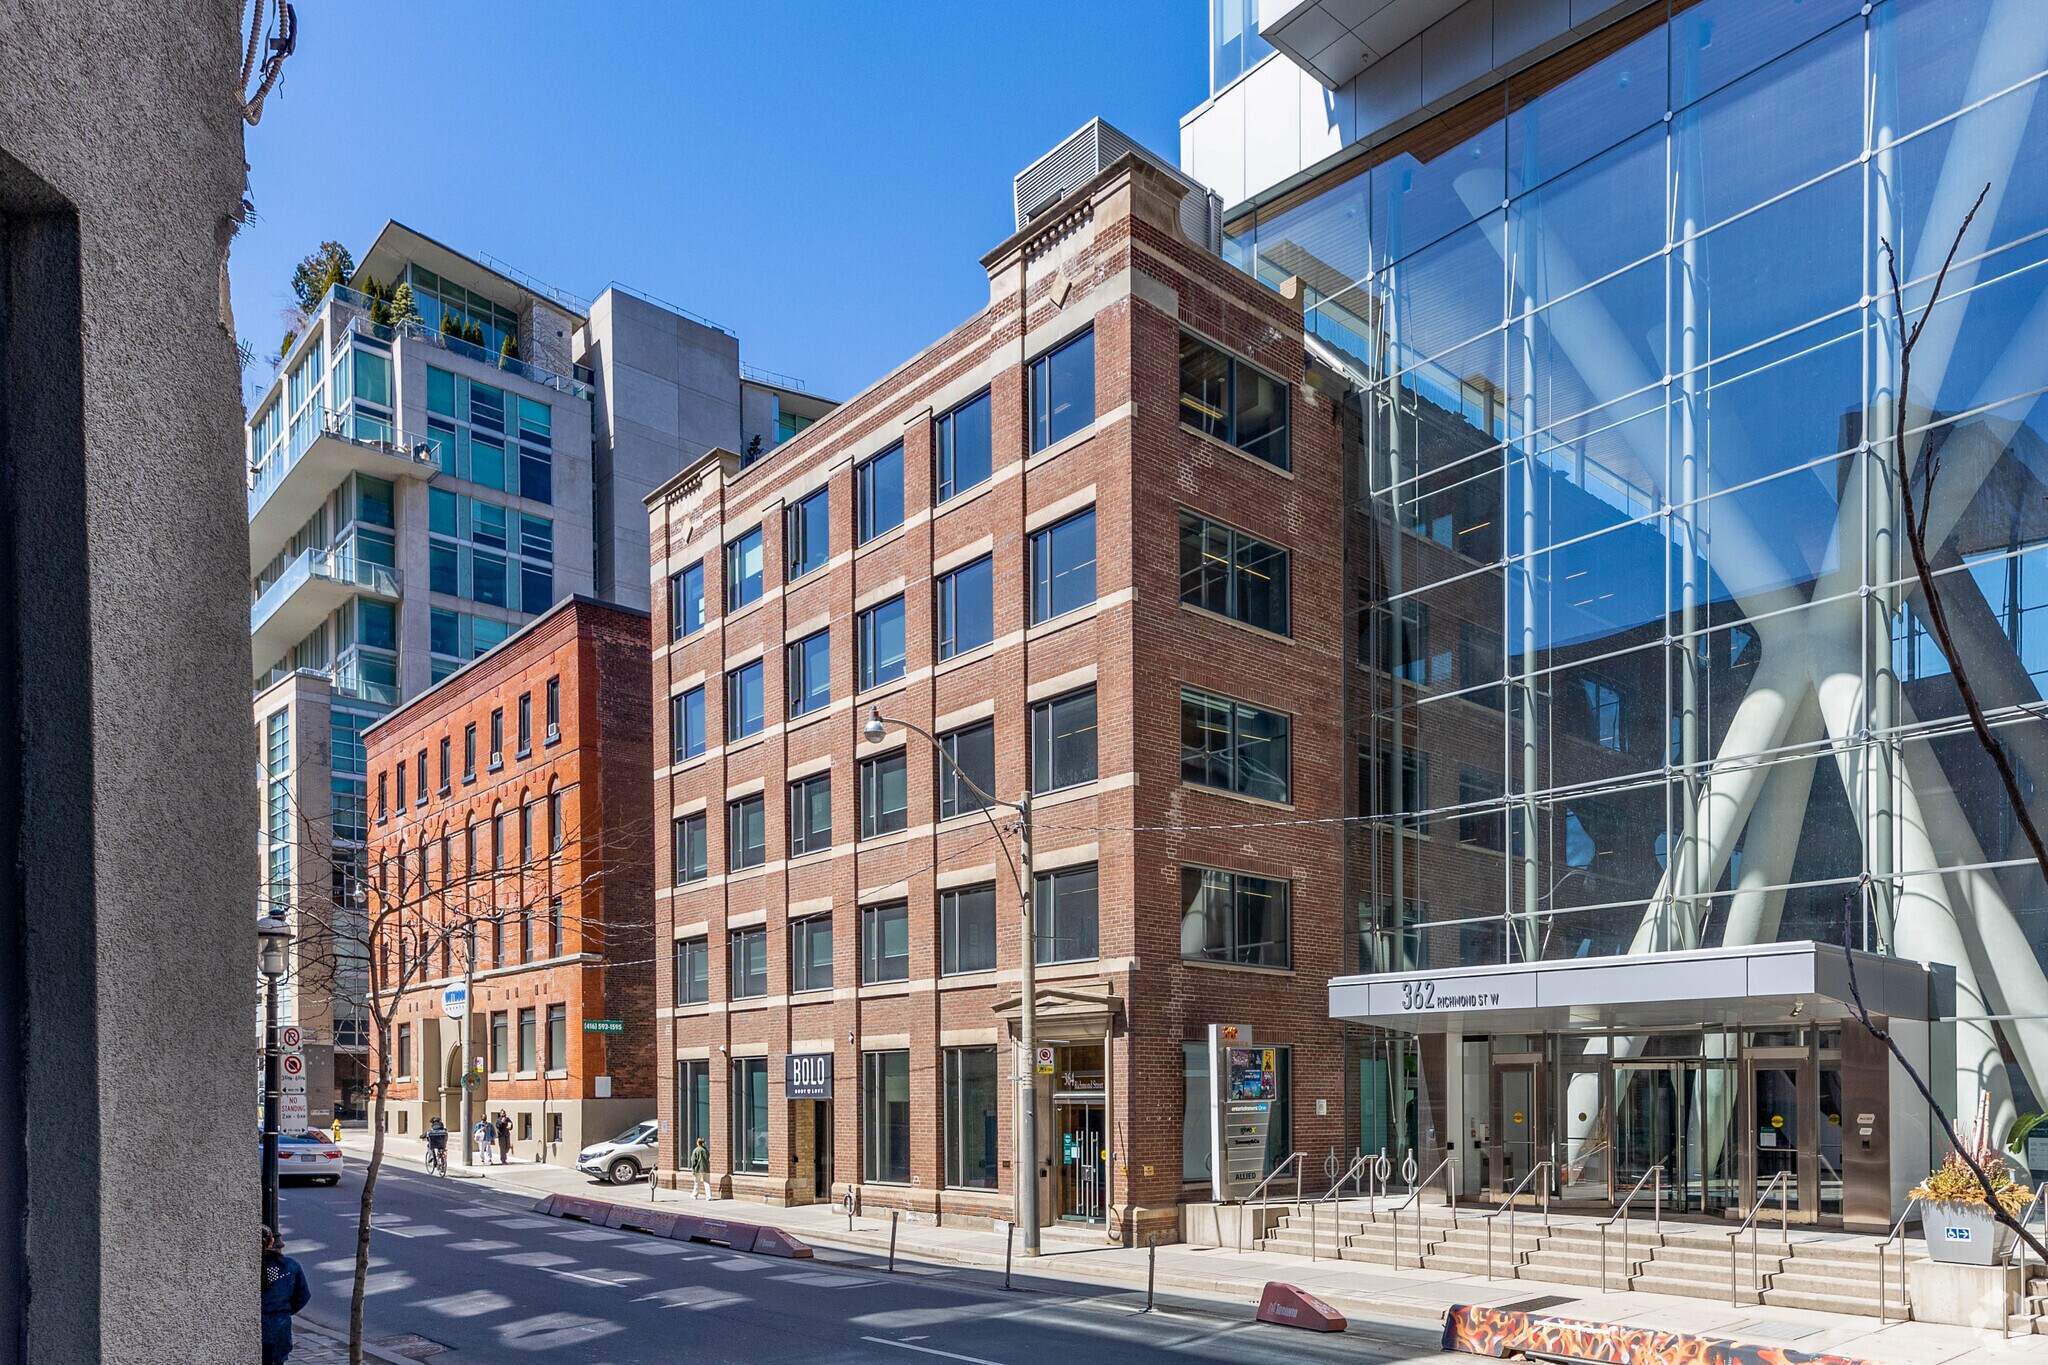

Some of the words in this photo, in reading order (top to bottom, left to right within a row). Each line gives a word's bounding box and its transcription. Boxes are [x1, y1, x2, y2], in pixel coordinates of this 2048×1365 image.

[1402, 980, 1435, 1010] 362
[1437, 994, 1477, 1009] RICHMOND
[1478, 993, 1488, 1007] ST
[1490, 992, 1499, 1006] W
[584, 1022, 598, 1030] (416)
[598, 1022, 622, 1031] 593-1595
[793, 1057, 825, 1086] BOLO
[1064, 1072, 1074, 1086] 364
[1074, 1080, 1093, 1089] Richmond
[1093, 1081, 1104, 1089] Street
